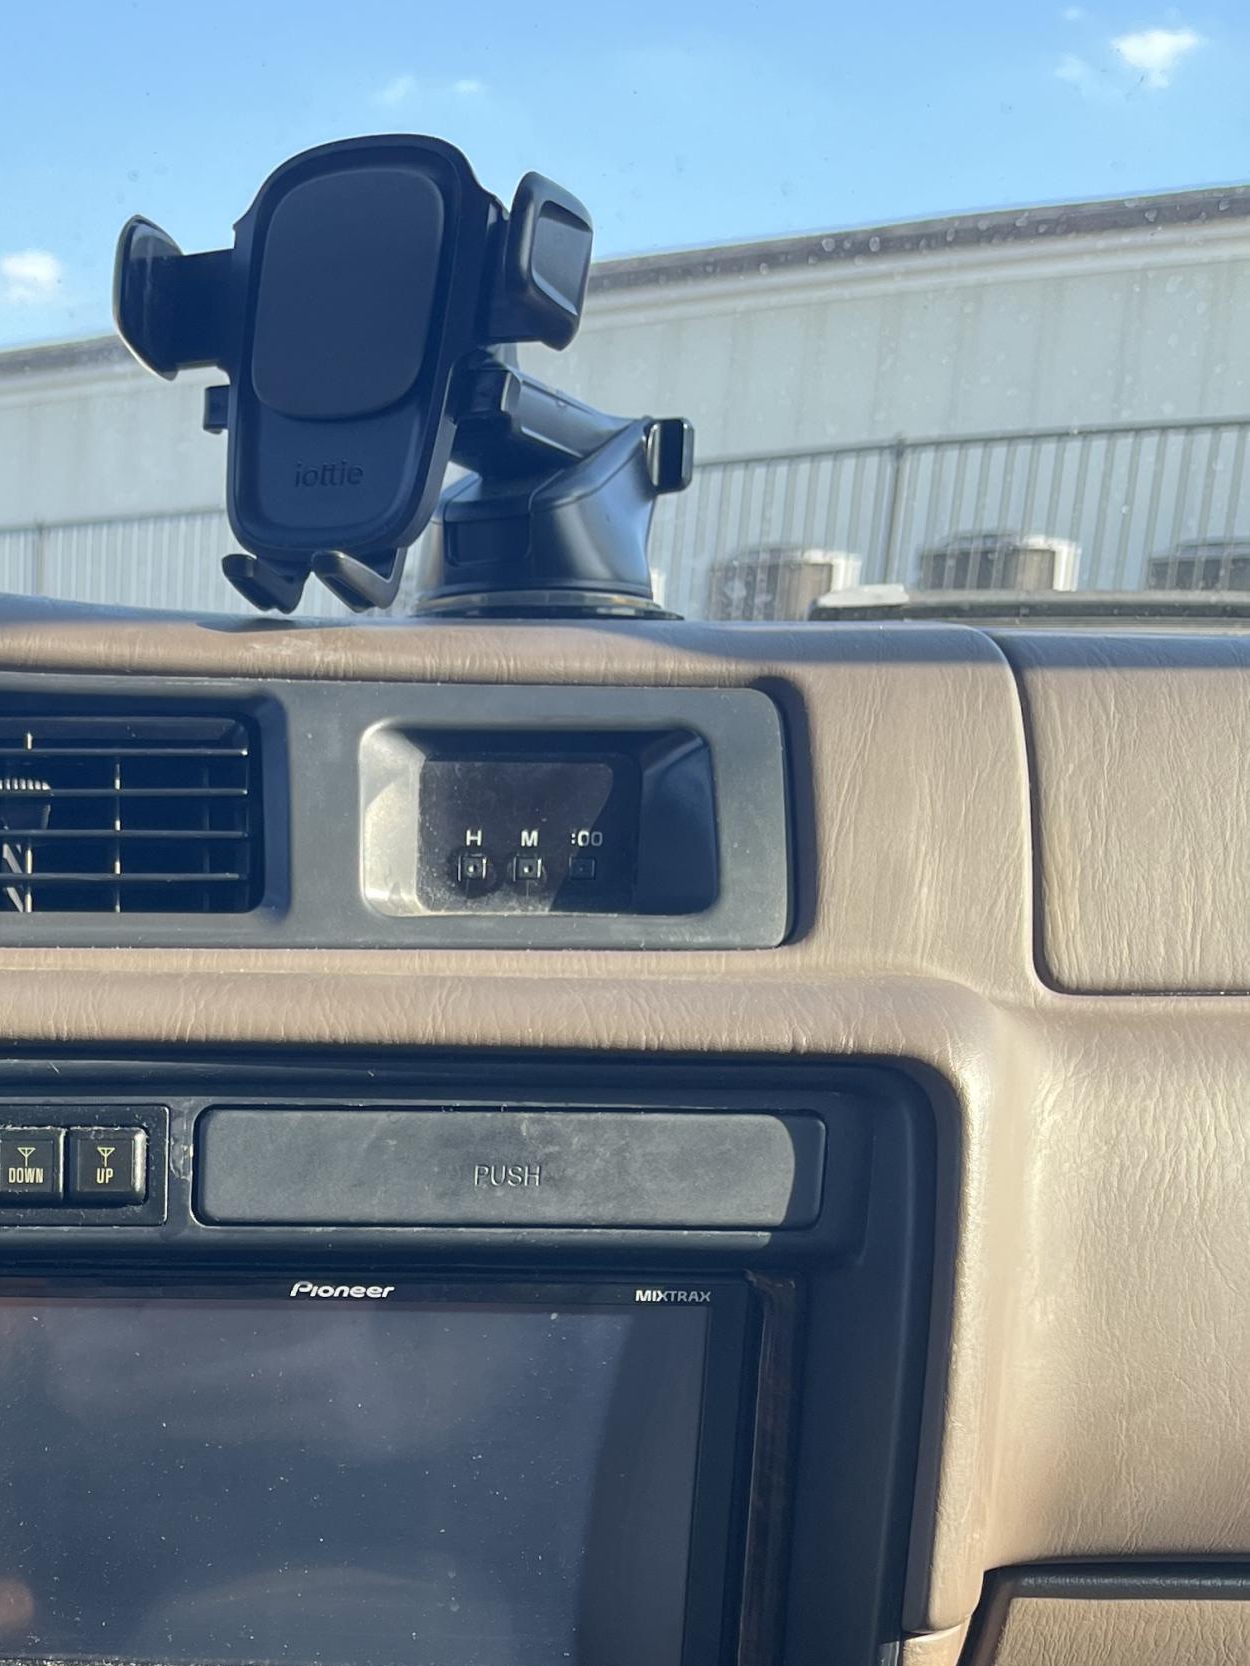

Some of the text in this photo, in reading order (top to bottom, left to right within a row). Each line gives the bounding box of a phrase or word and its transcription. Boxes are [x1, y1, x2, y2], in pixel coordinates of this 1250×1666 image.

[465, 830, 482, 847] H
[520, 830, 539, 847] M
[7, 1167, 44, 1184] DOWN
[96, 1168, 115, 1184] UP
[474, 1164, 542, 1188] PUSH
[289, 1280, 396, 1298] Pioneer
[634, 1289, 712, 1303] MIXTRAX
